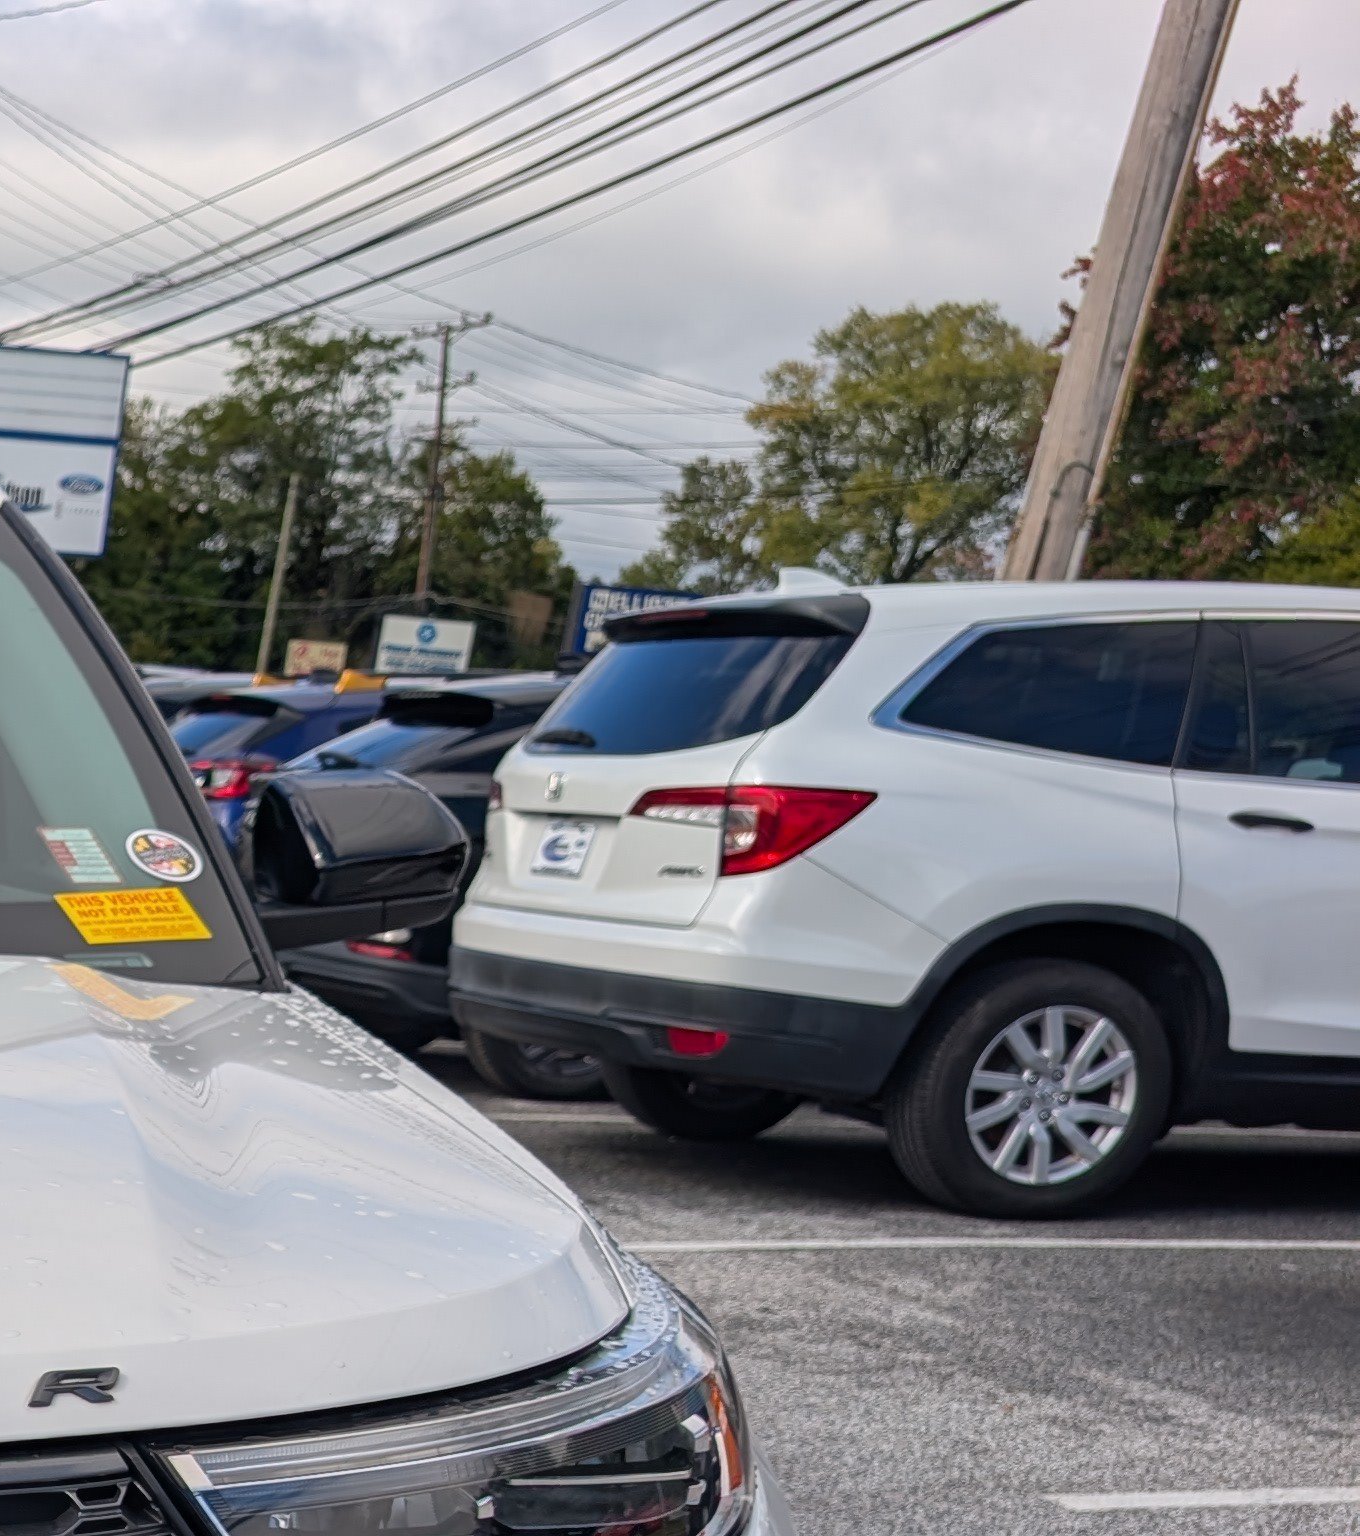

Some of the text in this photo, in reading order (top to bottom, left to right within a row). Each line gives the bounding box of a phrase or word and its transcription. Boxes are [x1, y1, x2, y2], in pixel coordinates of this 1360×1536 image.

[65, 890, 176, 908] THIS VEHICLE
[77, 904, 182, 918] NOT FOR SALE
